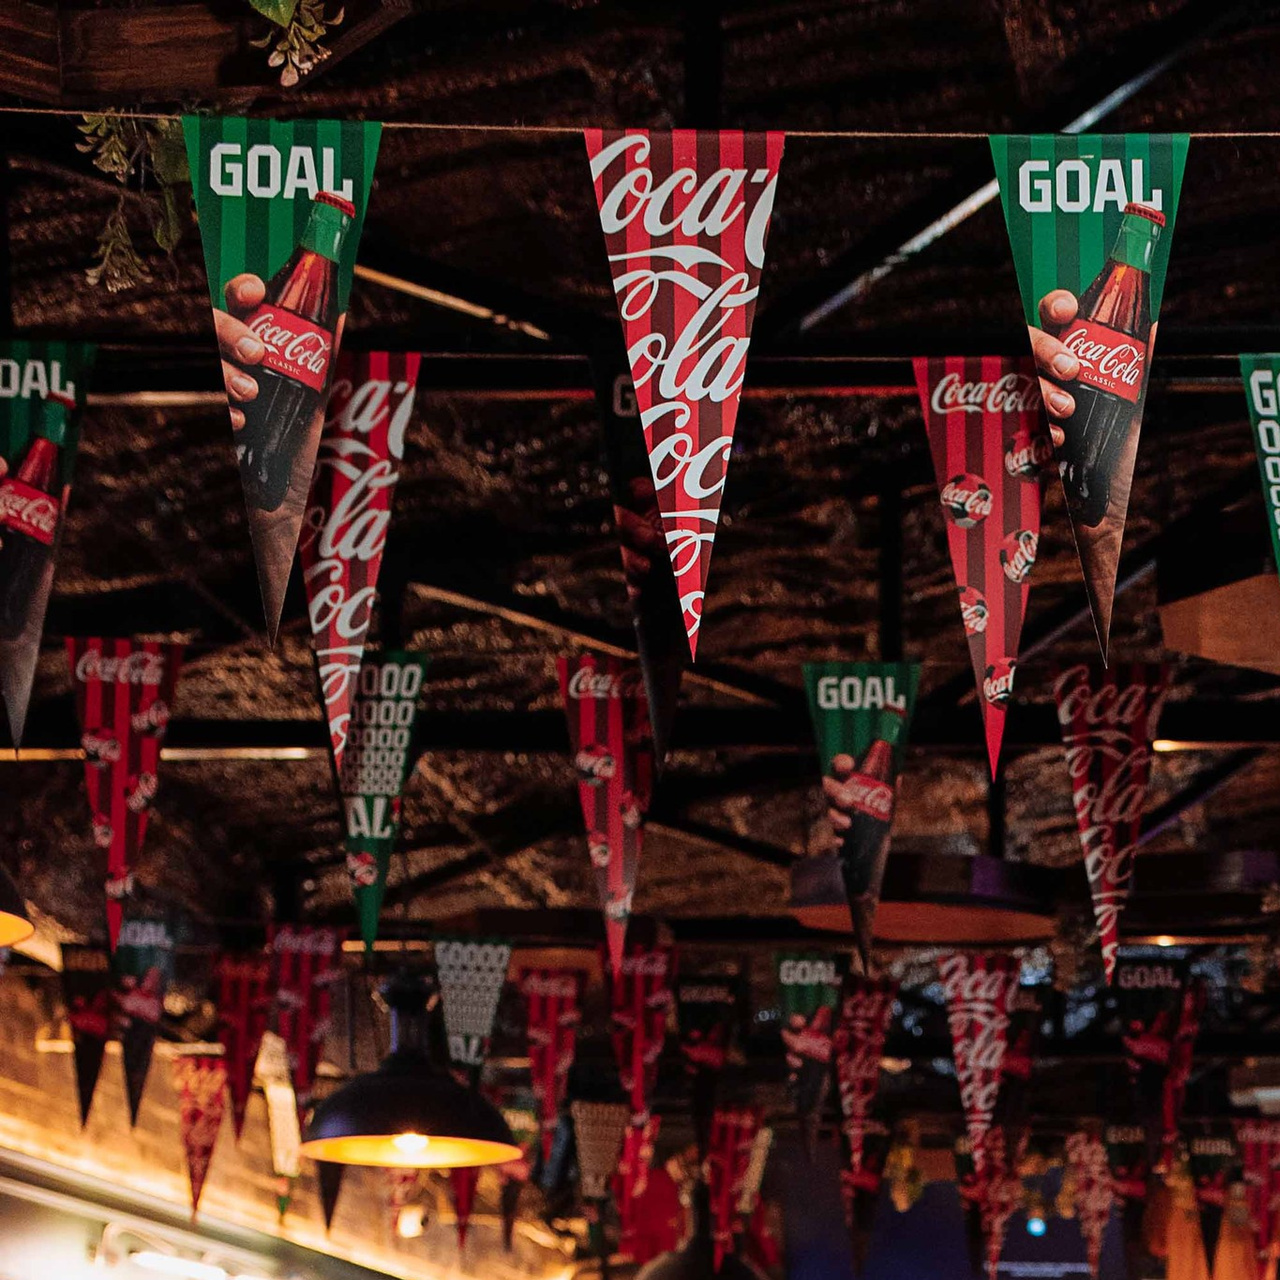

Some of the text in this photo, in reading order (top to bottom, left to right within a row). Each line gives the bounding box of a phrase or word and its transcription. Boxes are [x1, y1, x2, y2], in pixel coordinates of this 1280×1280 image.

[209, 142, 354, 201] GOAL
[1018, 159, 1163, 213] GOAL
[249, 312, 331, 375] Coca-Cola
[1063, 328, 1146, 387] Coca-Cola
[1083, 371, 1117, 390] CLASSIC
[817, 675, 907, 711] GOAL
[345, 796, 392, 839] AL
[780, 959, 843, 986] GOAL
